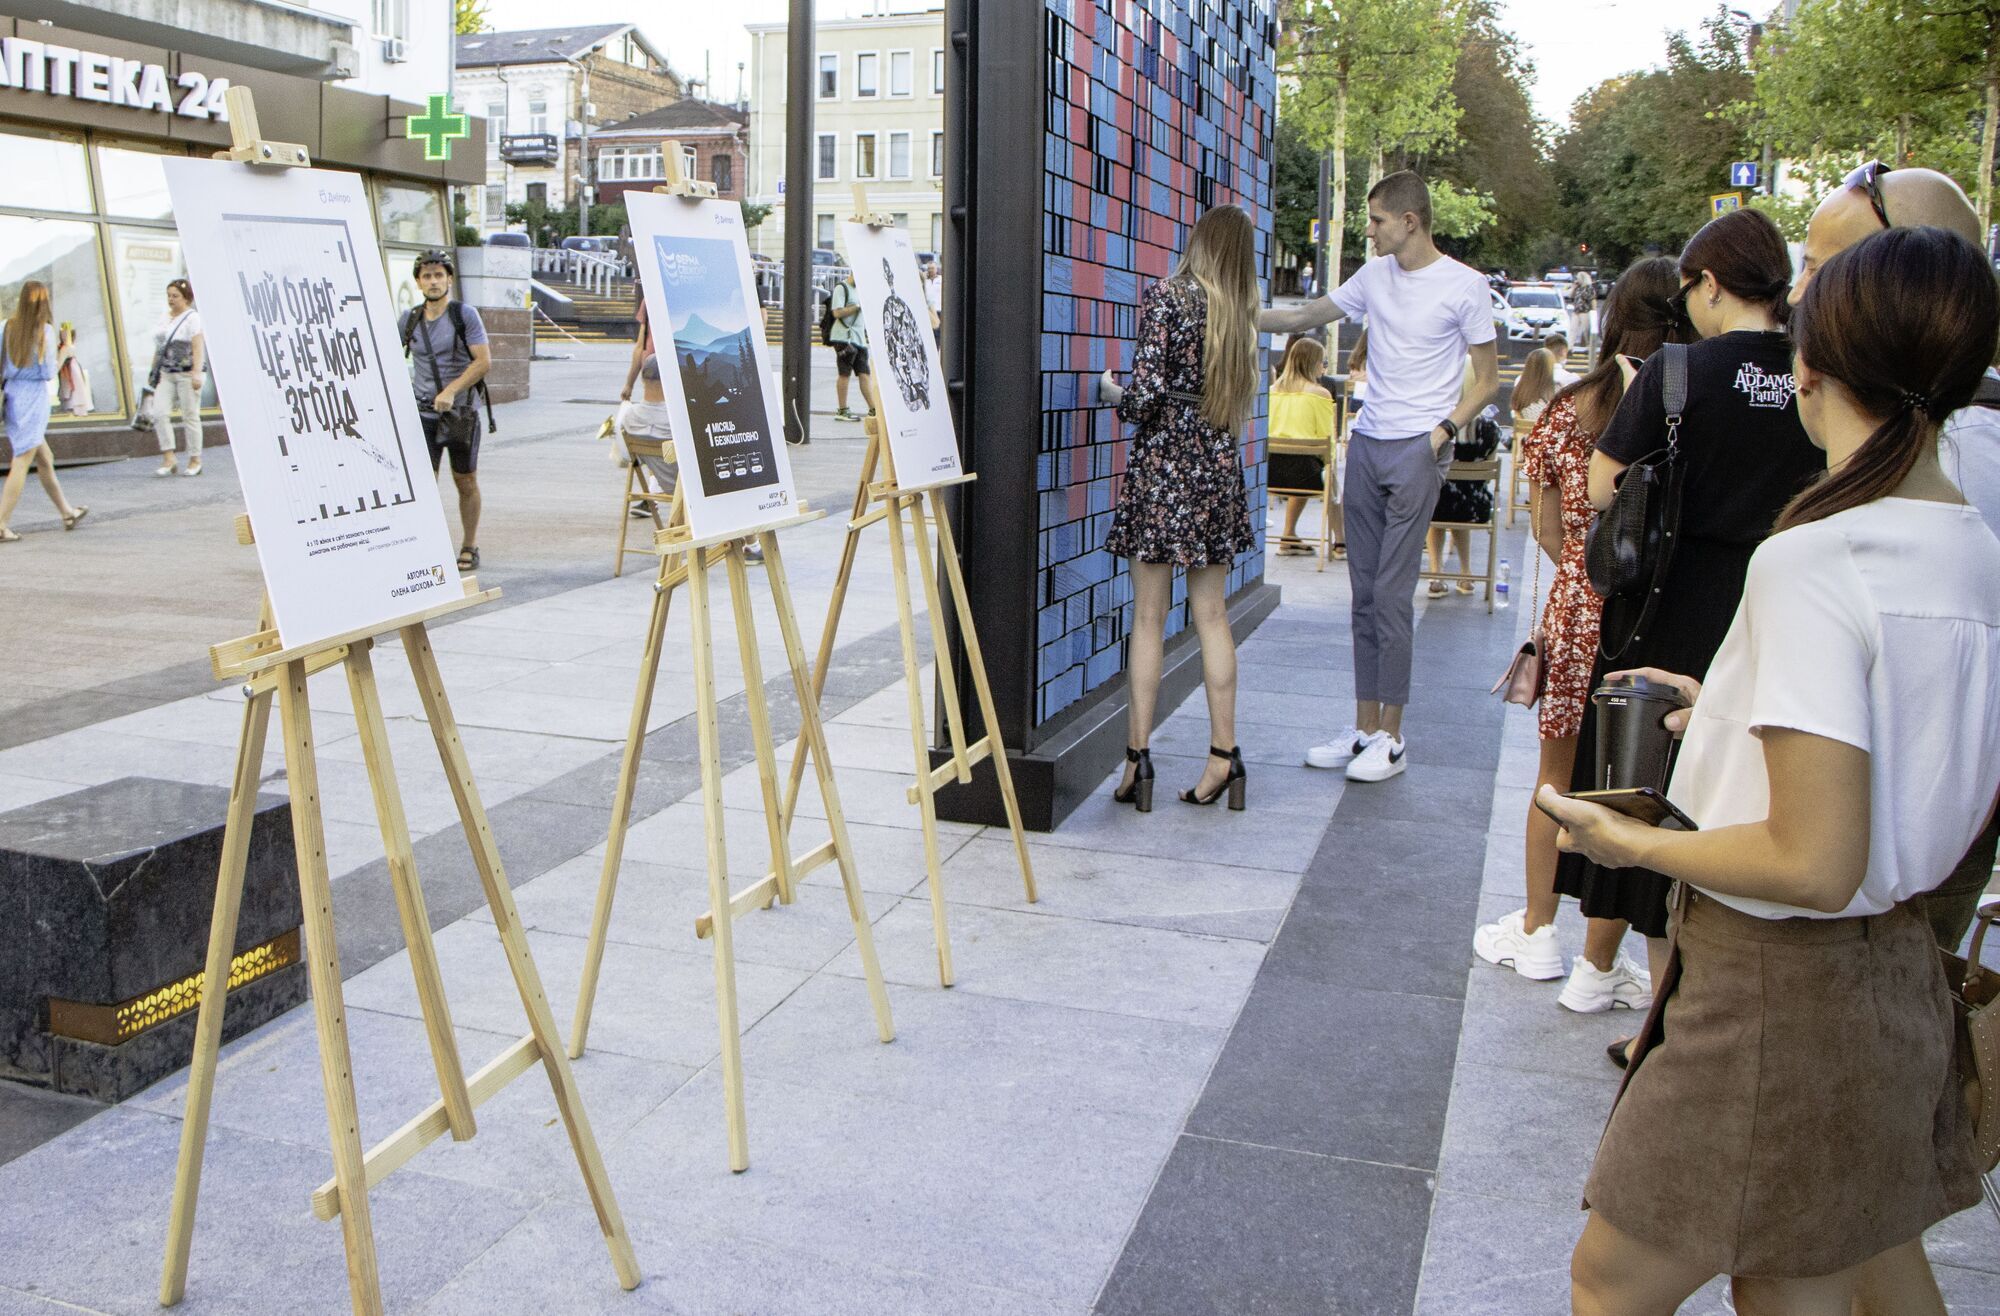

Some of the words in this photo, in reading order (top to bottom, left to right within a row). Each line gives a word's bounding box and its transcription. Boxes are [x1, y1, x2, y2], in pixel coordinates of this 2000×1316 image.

[177, 71, 230, 122] 24
[328, 191, 352, 204] Дніпро
[238, 271, 287, 328] МІЙ
[283, 275, 336, 334] ОДЯГ
[251, 325, 291, 389] ЦЕ
[288, 327, 323, 382] НЕ
[318, 327, 367, 381] МОЯ
[1742, 361, 1763, 374] The
[1732, 369, 1796, 393] ADDAMS
[285, 380, 361, 440] ЗГОДА
[1749, 386, 1792, 410] Family
[705, 423, 714, 447] 1
[711, 421, 736, 433] МІСЯЦЬ
[714, 430, 759, 446] БЕЗКОШТОВНО
[391, 586, 410, 598] ОЛЕНА
